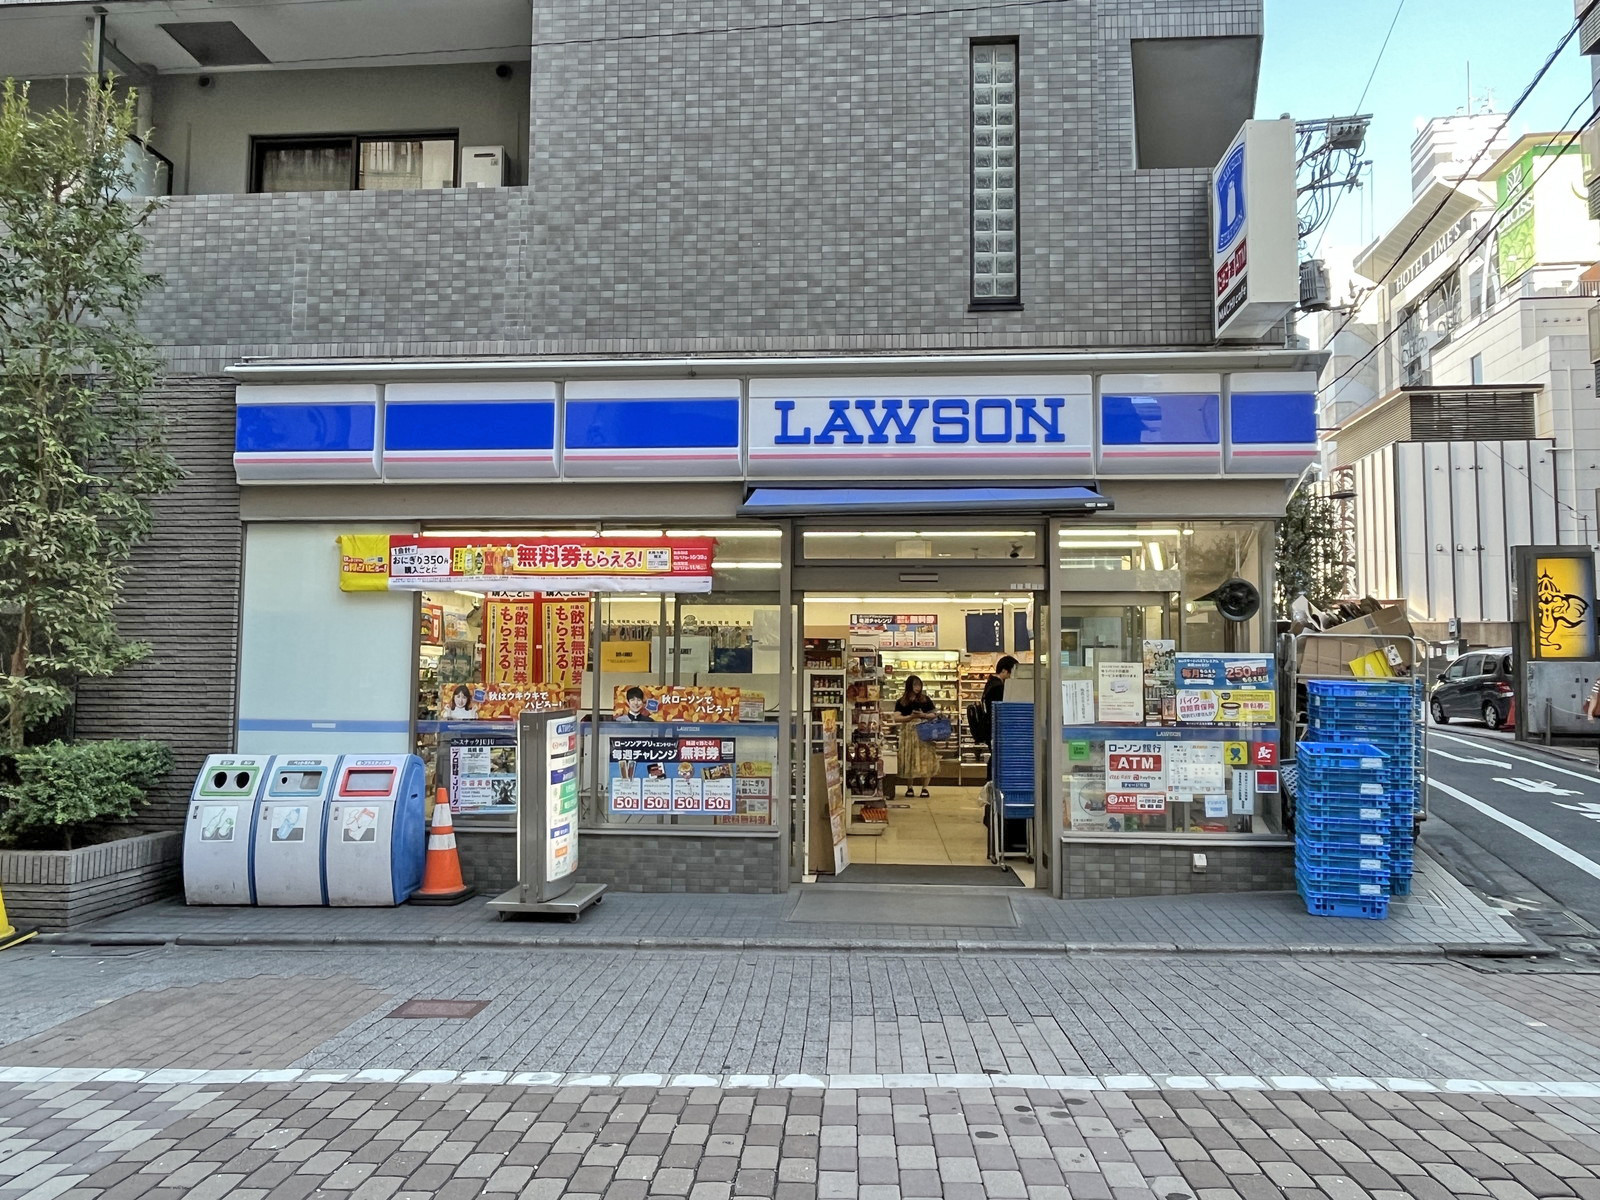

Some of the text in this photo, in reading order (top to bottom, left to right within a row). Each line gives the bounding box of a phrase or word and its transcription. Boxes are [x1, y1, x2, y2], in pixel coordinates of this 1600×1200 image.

[1394, 254, 1425, 293] HOTEL
[774, 397, 1065, 445] LAWSON
[393, 555, 449, 565] おにぎり350円
[516, 545, 643, 568] 無料券もらえる!
[404, 566, 438, 574] 購入ごとに
[1181, 668, 1200, 679] 毎月
[1226, 665, 1252, 679] 250
[488, 691, 549, 701] 秋はウキウキで
[661, 694, 714, 705] 秋ローソンで
[1180, 696, 1200, 705] バイク
[695, 705, 734, 715] ハピろー!
[460, 738, 495, 746] スナックJUJU
[680, 746, 719, 760] 無料券
[1108, 743, 1162, 753] ローソン銀行
[612, 749, 678, 760] 毎週チャレンジ
[1117, 757, 1155, 769] ATM
